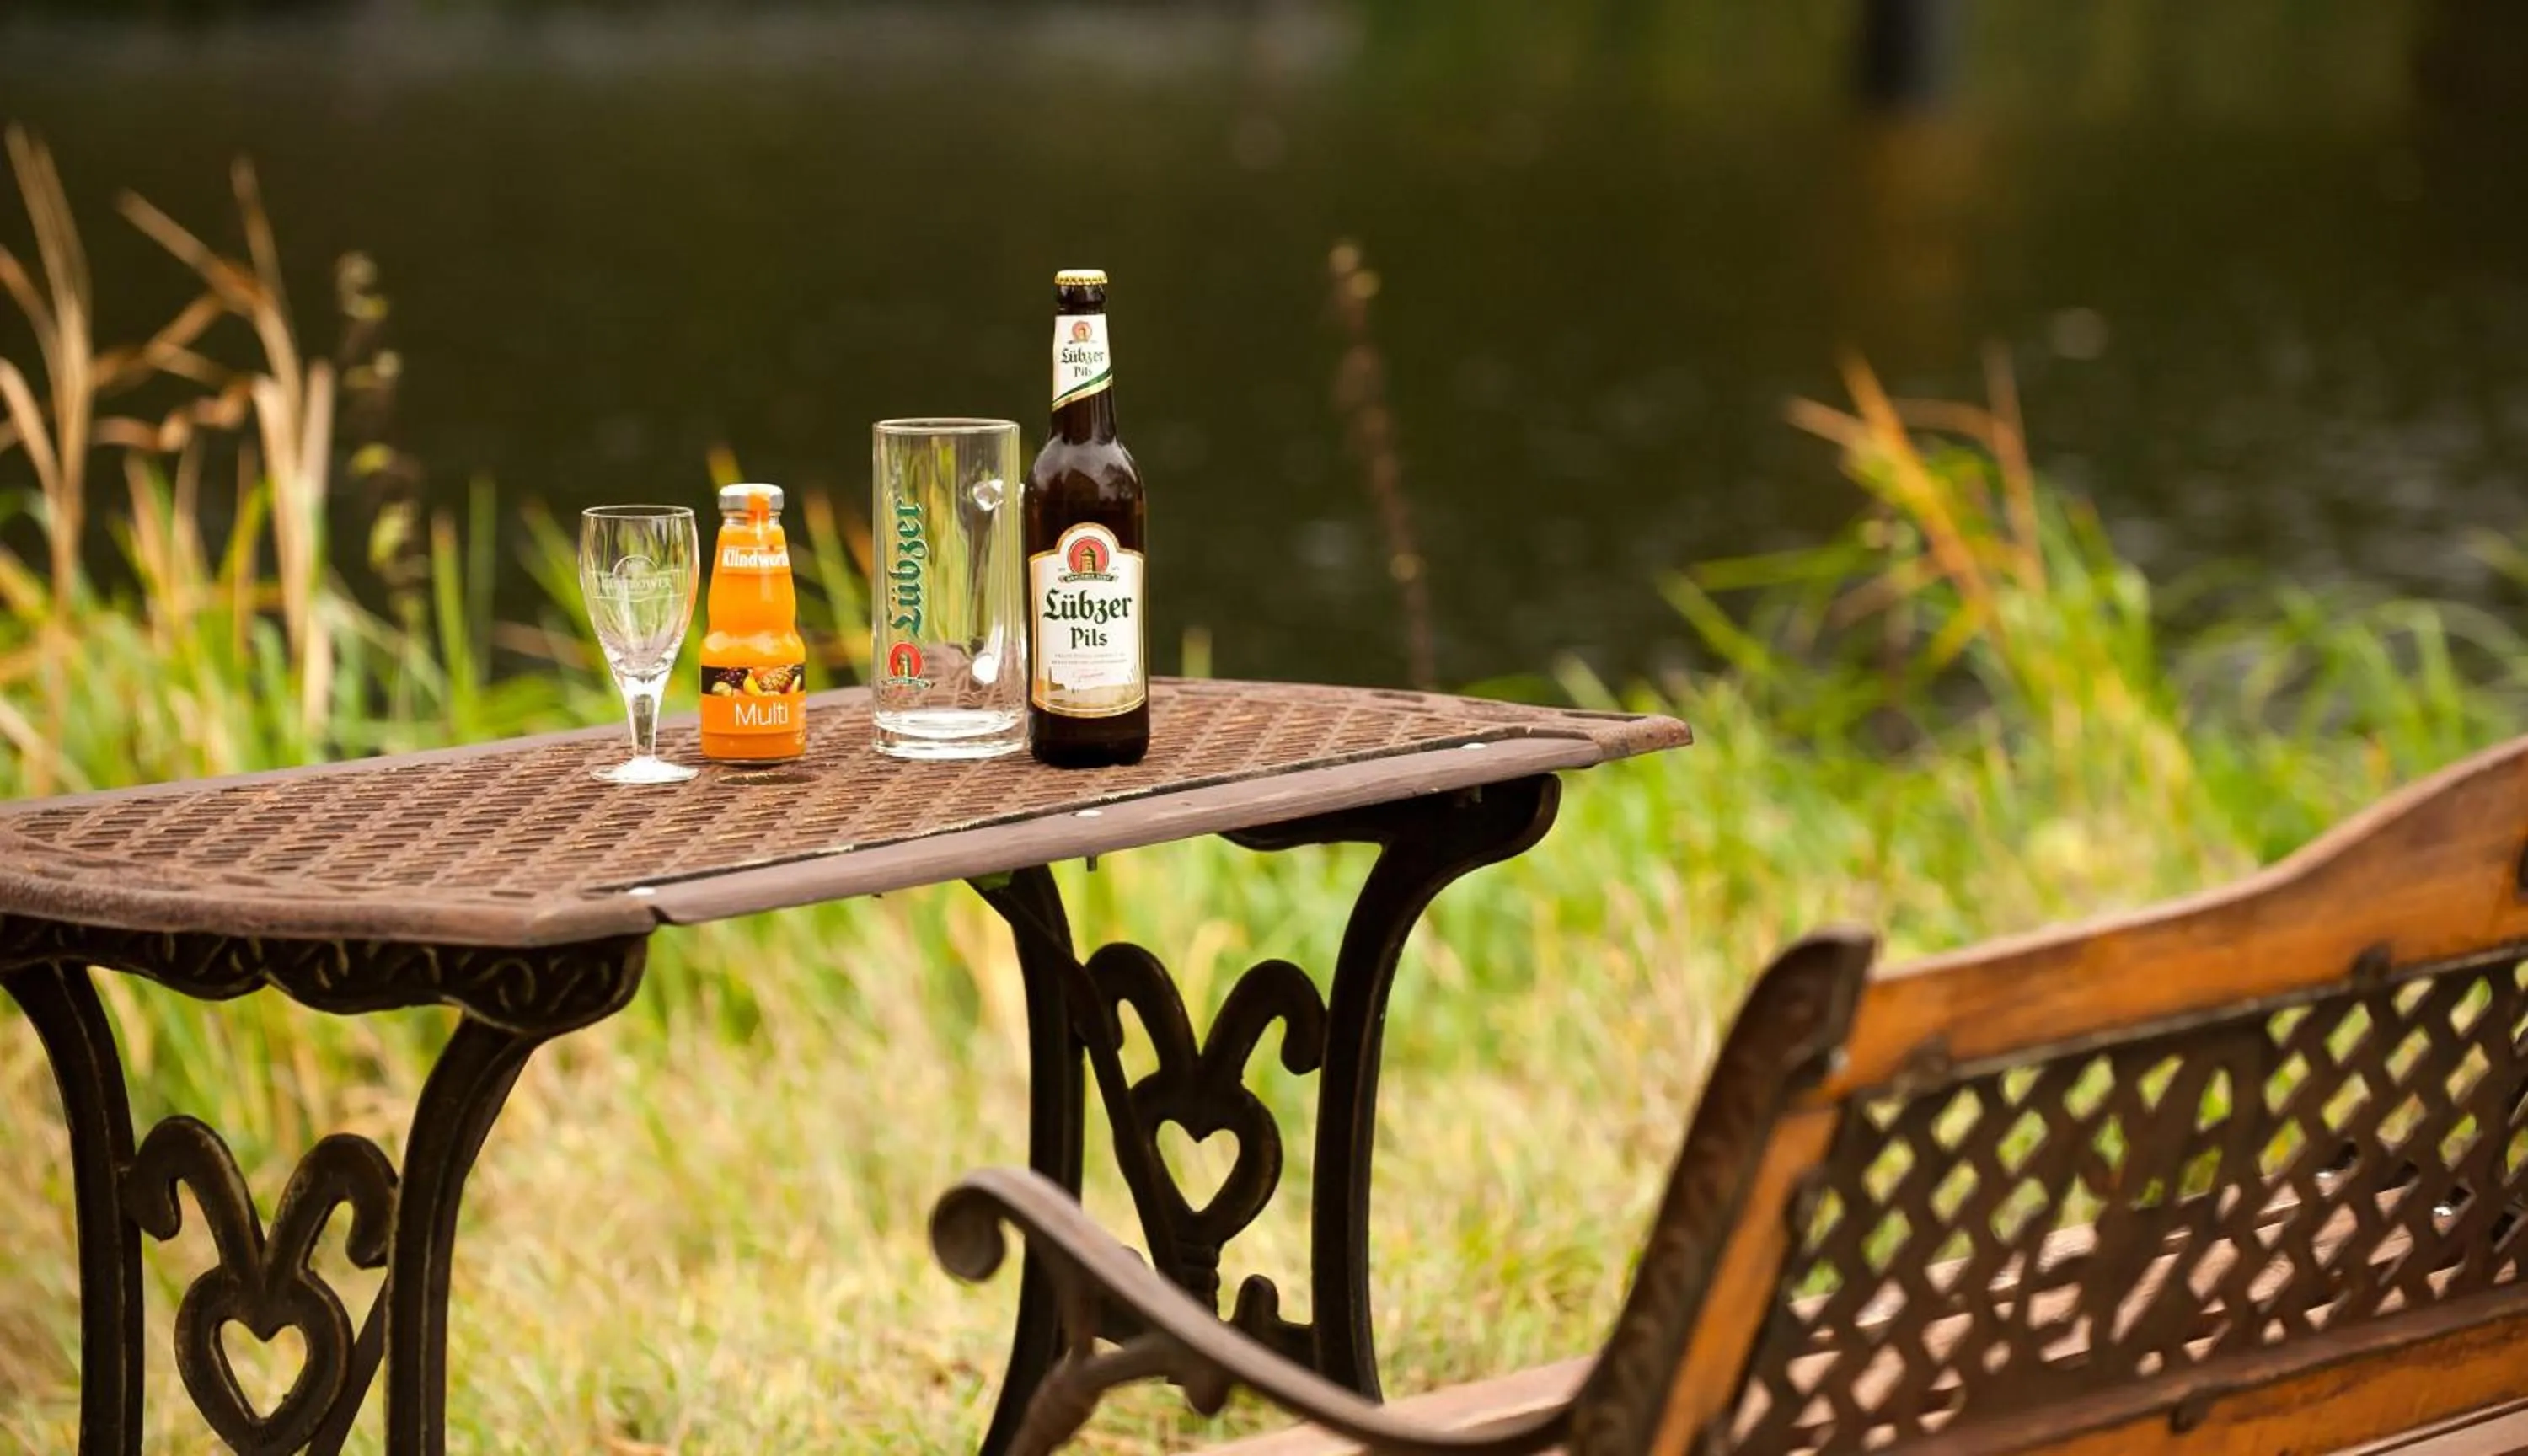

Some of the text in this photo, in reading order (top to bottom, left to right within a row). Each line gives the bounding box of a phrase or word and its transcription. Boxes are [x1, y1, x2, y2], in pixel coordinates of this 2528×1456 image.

[1061, 347, 1104, 365] Lübzer
[1074, 366, 1093, 377] Pils
[888, 497, 929, 638] Lübzer
[1042, 587, 1133, 624] Lübzer
[1070, 626, 1108, 650] Pils
[734, 701, 790, 725] Multi
